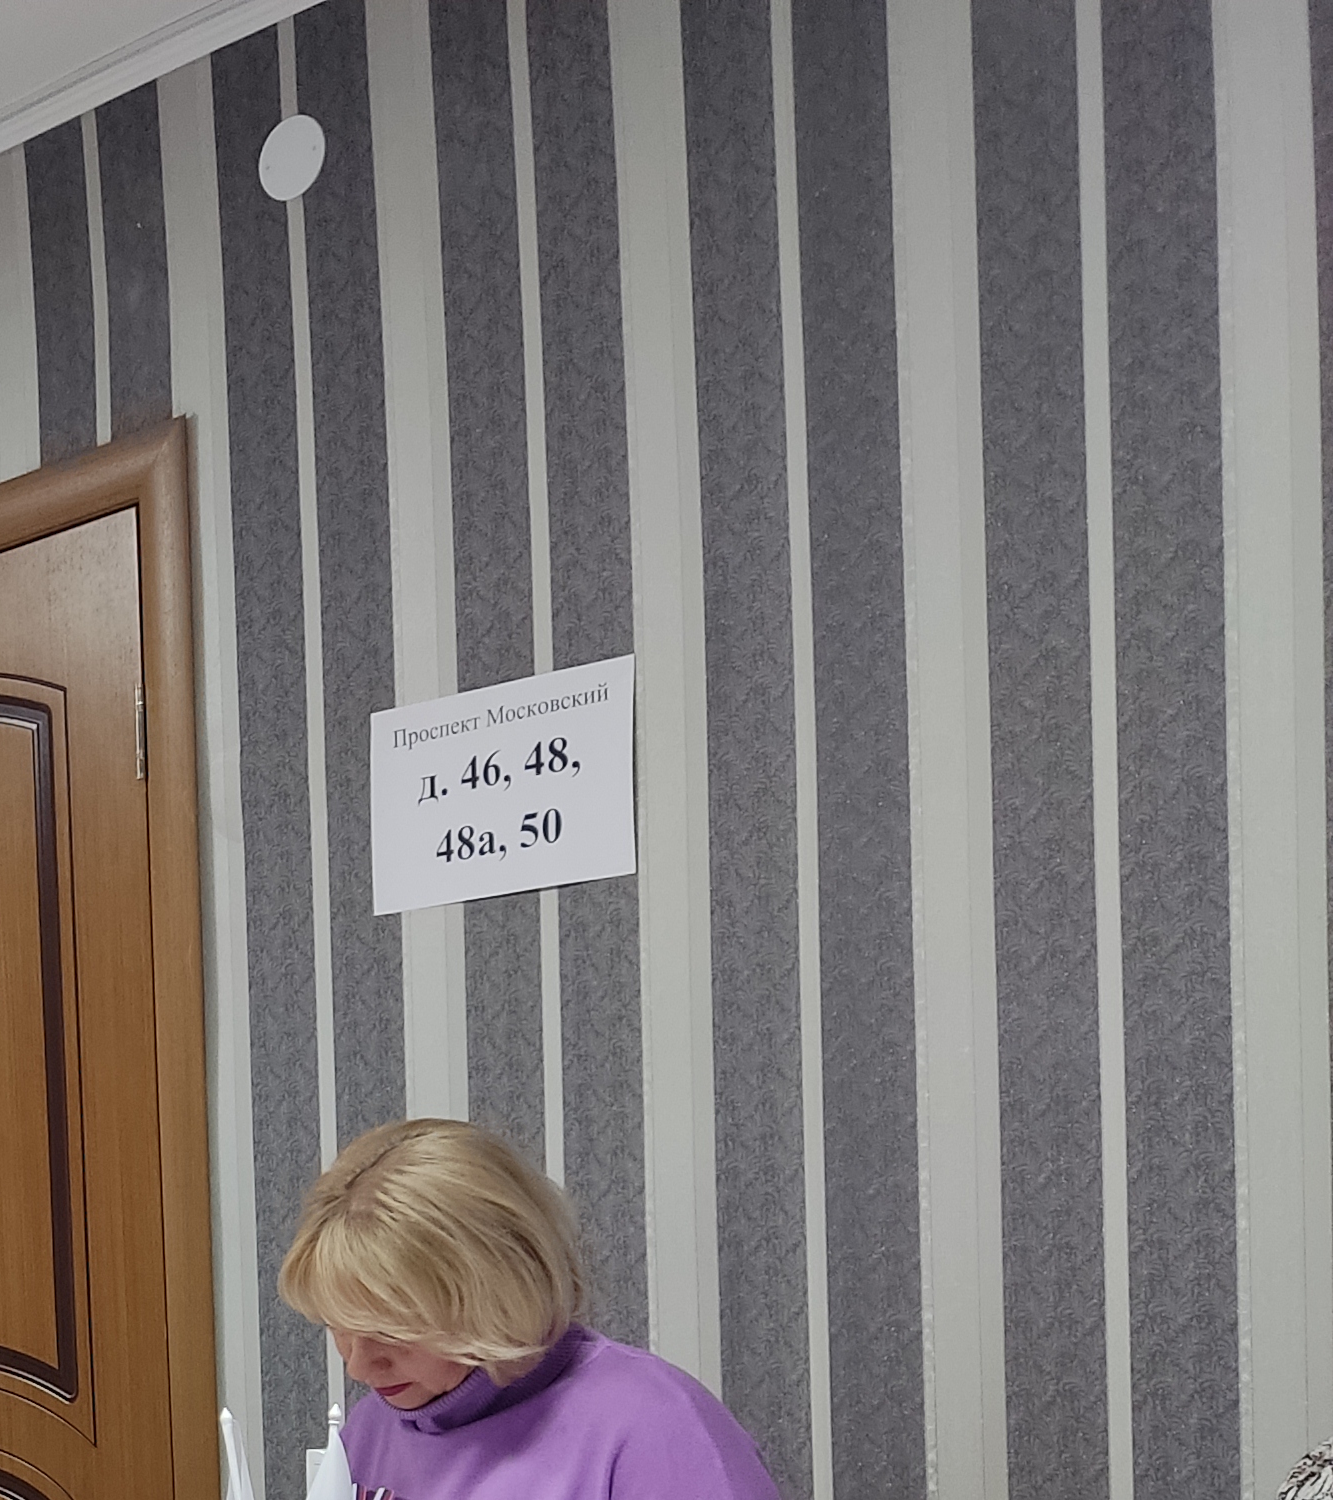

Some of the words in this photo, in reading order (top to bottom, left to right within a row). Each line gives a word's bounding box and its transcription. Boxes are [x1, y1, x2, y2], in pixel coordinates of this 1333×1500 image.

[393, 715, 480, 750] Проспект
[486, 682, 609, 728] Московский
[417, 774, 448, 806] д.
[461, 750, 511, 791] 46,
[524, 737, 581, 777] 48,
[436, 825, 507, 863] 48а,
[520, 808, 562, 848] 50
